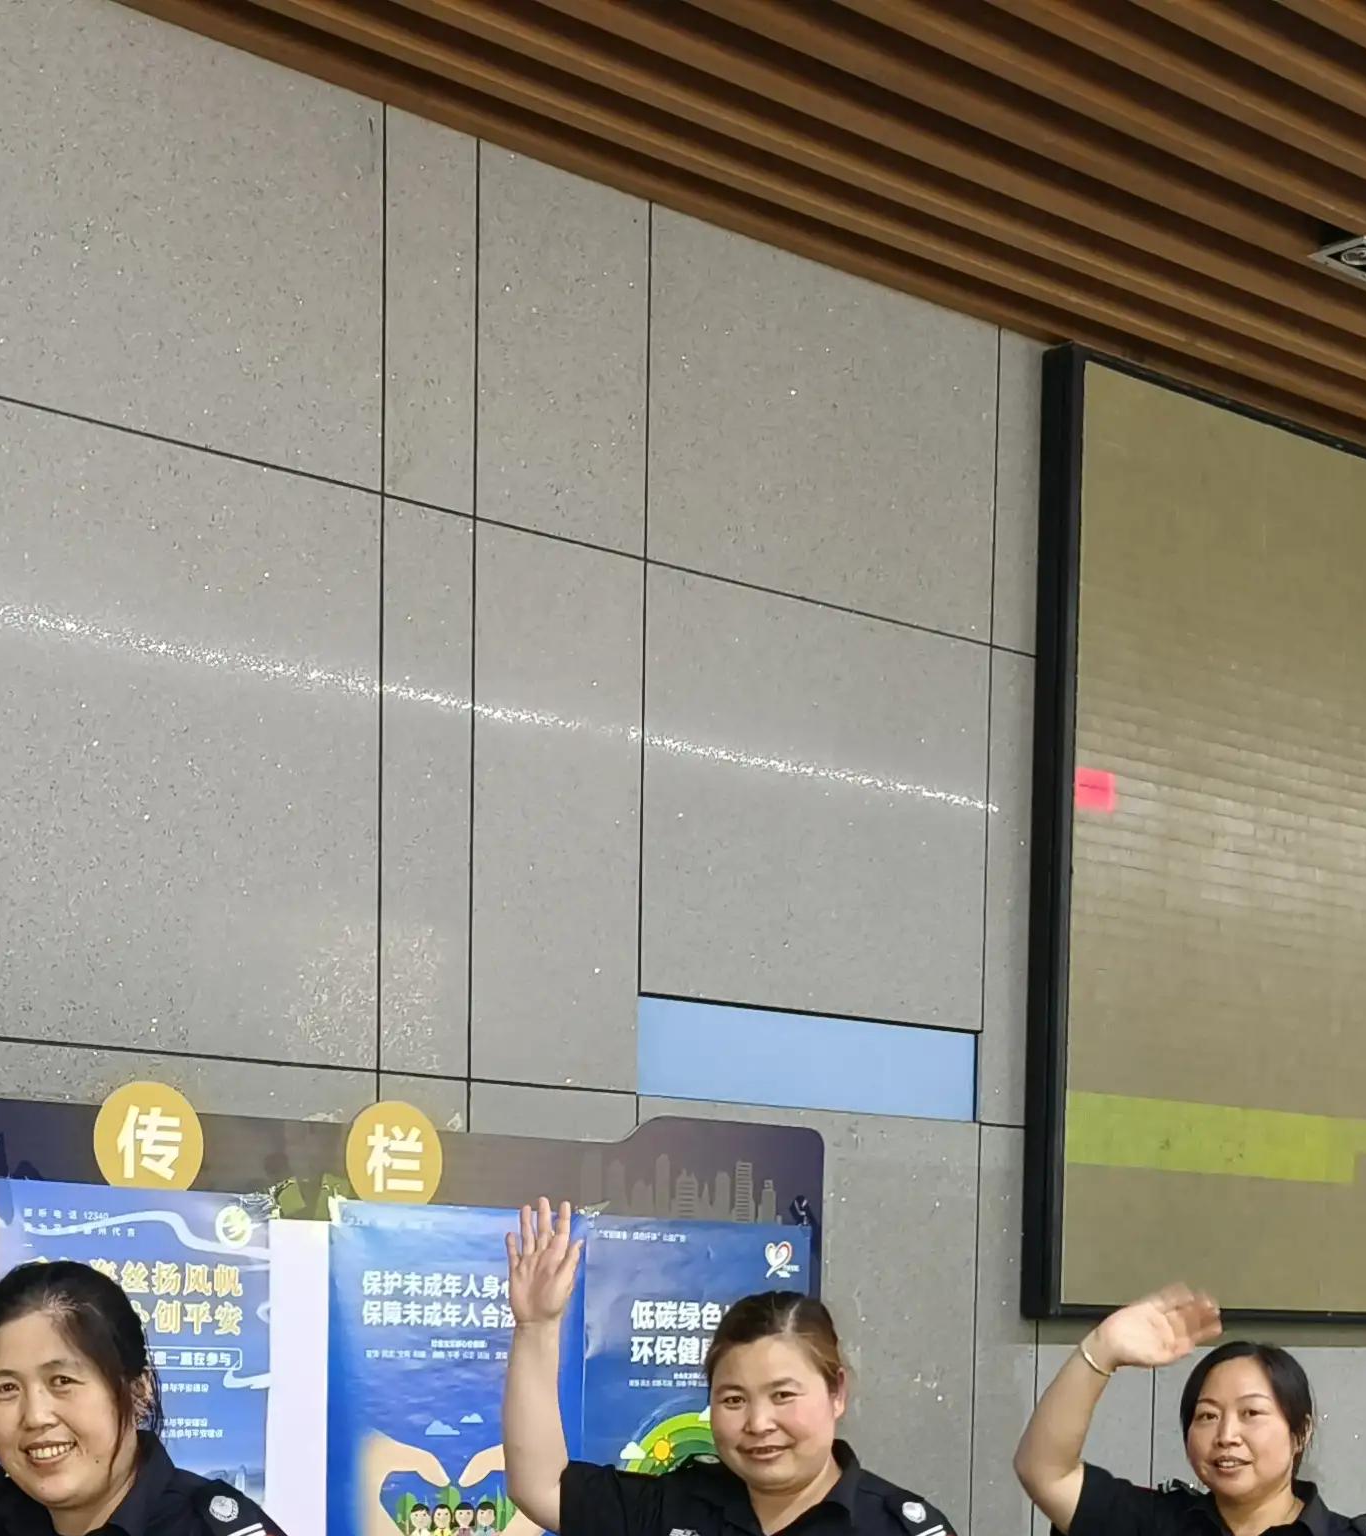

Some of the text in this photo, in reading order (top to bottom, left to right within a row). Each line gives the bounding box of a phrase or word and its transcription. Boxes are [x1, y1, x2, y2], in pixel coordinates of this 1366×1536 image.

[117, 1105, 184, 1182] 传
[366, 1123, 425, 1193] 栏
[630, 1299, 728, 1331] 低碳绿色
